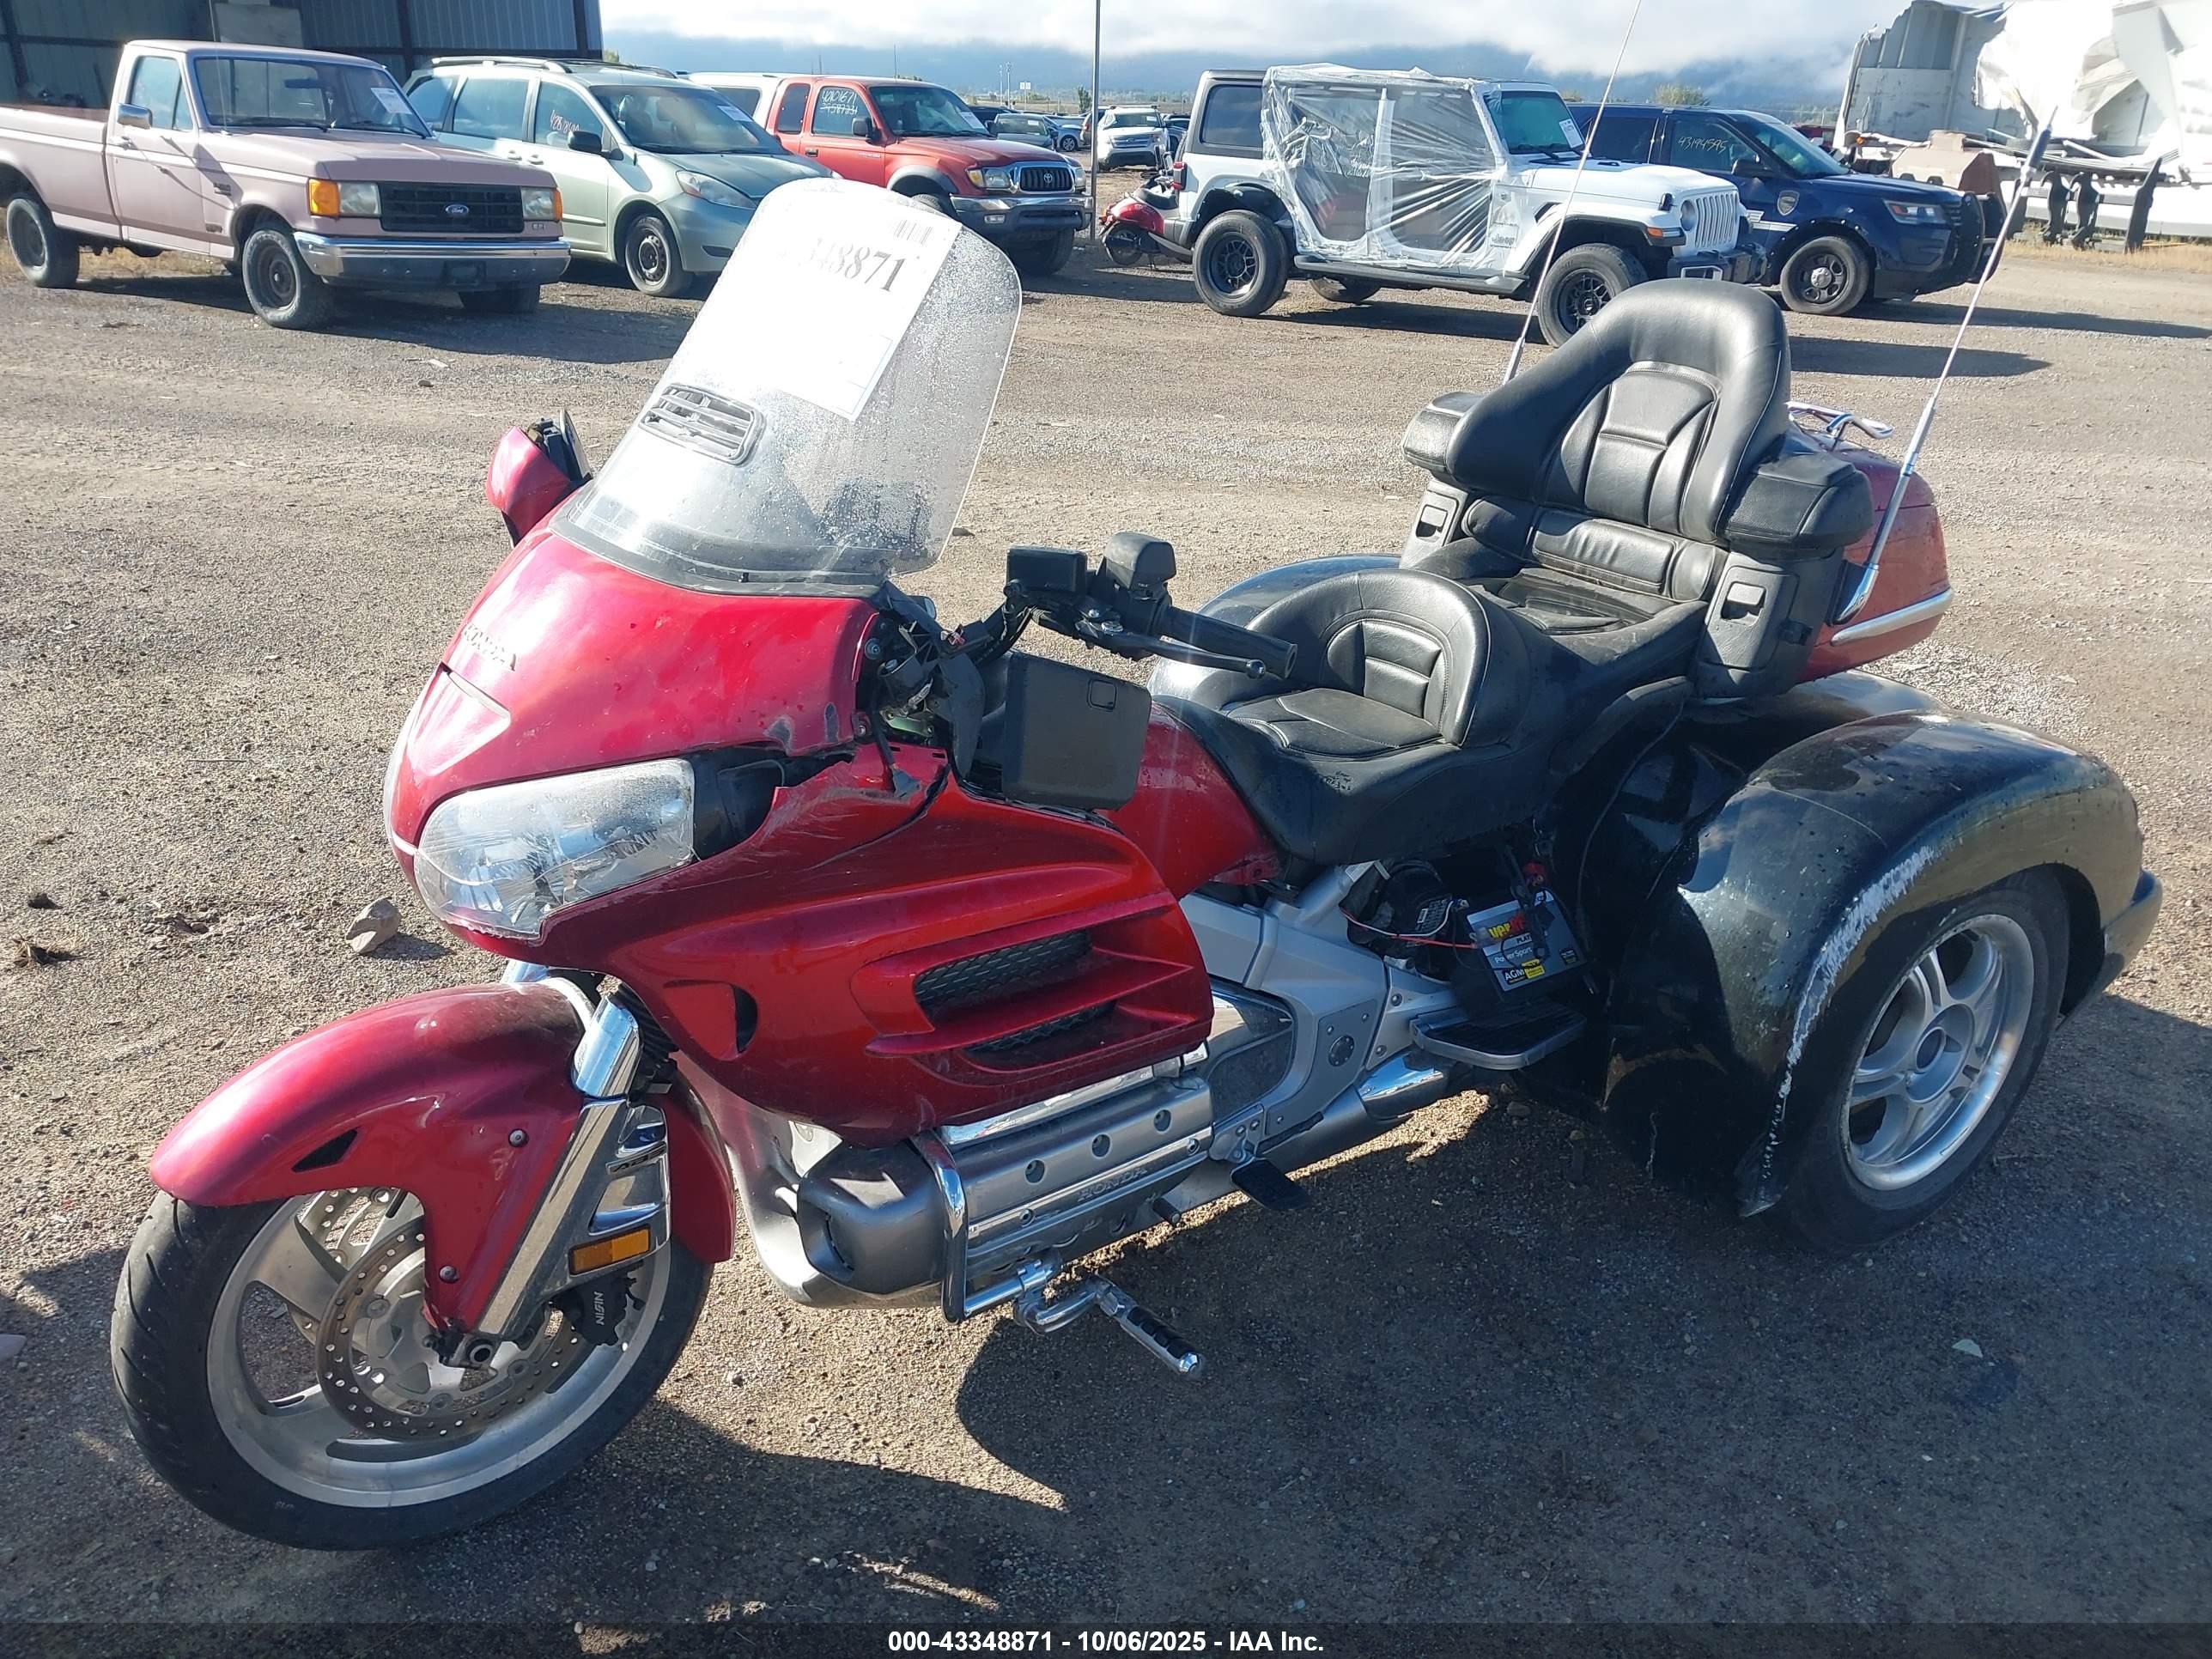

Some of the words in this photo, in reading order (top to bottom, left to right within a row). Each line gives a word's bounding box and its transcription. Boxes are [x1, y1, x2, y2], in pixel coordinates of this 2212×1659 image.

[1677, 137, 1729, 155] 43194595
[1504, 967, 1525, 981] AGM
[1077, 1168, 1148, 1202] HONDA
